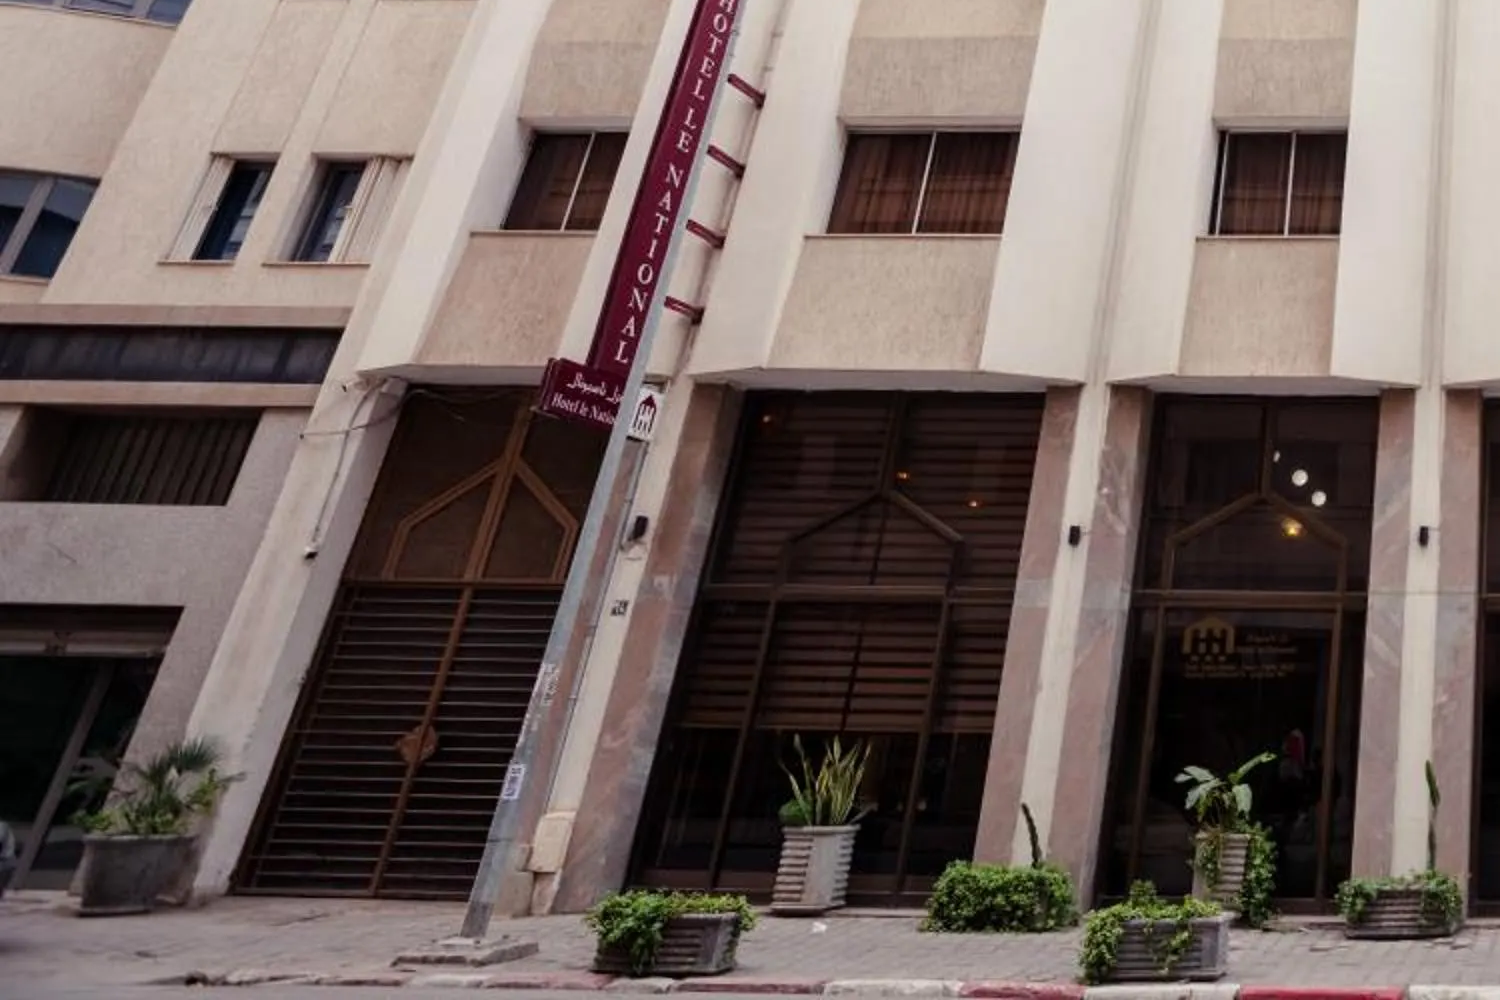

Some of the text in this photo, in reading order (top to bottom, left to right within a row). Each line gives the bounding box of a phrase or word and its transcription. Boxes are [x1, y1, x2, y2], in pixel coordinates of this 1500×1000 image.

[677, 107, 697, 154] LE
[616, 163, 684, 364] NATIONAL
[551, 393, 616, 425] Hotel le Natio
